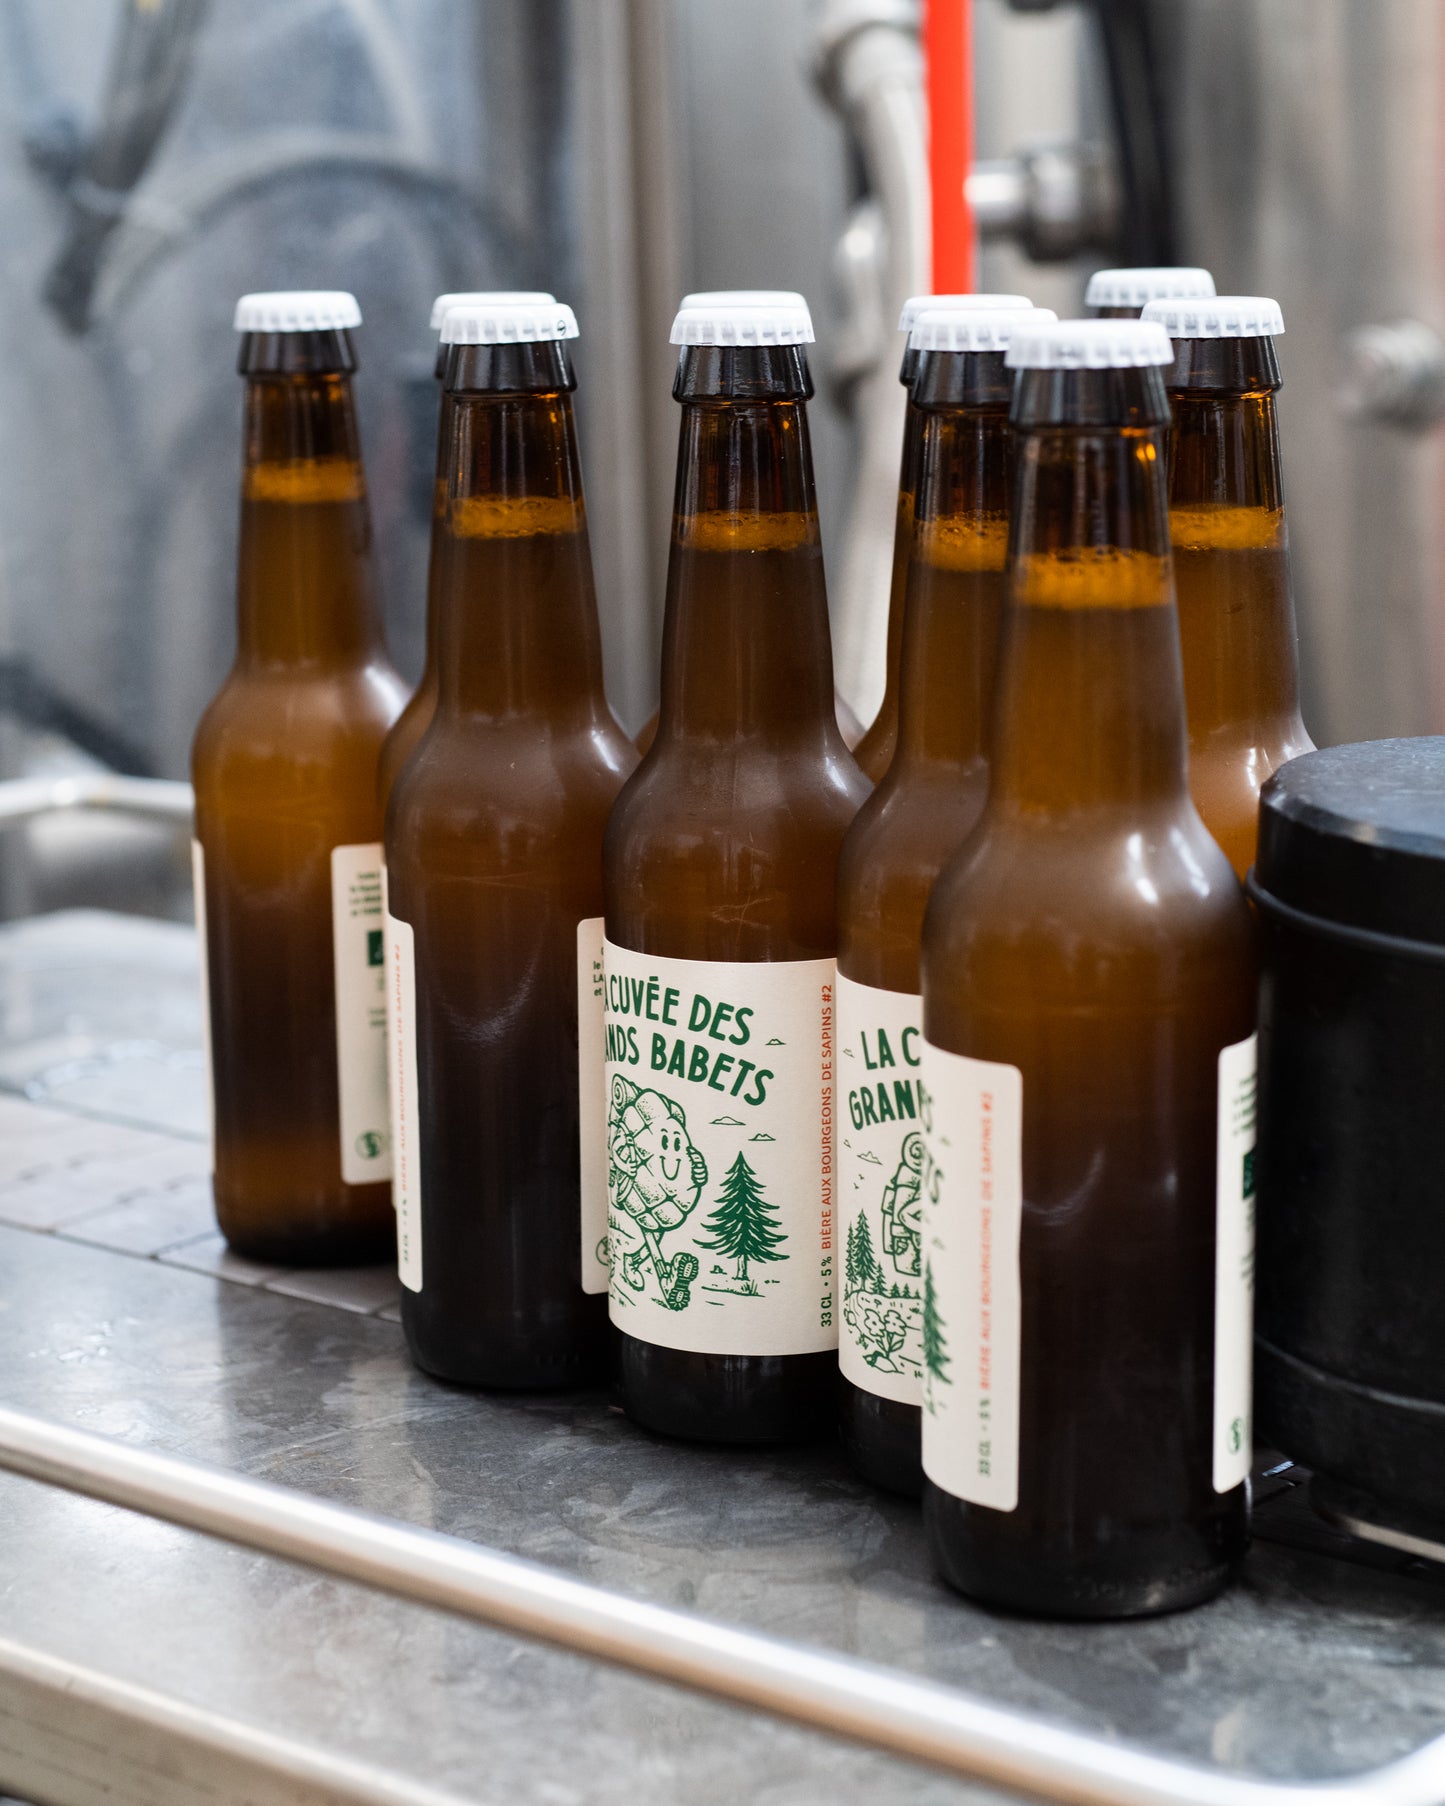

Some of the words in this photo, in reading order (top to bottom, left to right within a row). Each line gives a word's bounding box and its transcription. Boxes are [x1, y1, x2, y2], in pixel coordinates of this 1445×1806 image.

[610, 974, 680, 1027] CUVÉE
[688, 994, 754, 1046] DES
[821, 985, 832, 1003] #2
[821, 1007, 832, 1058] SAPINS
[860, 1028, 896, 1070] LA
[651, 1032, 774, 1106] BABETS
[821, 1061, 832, 1081] DE
[848, 1079, 922, 1131] GRAN
[821, 1087, 832, 1174] BOURGEONS
[821, 1177, 832, 1206] AUX
[820, 1210, 832, 1250] BIÈRE
[821, 1292, 832, 1309] CL
[821, 1311, 832, 1328] 33
